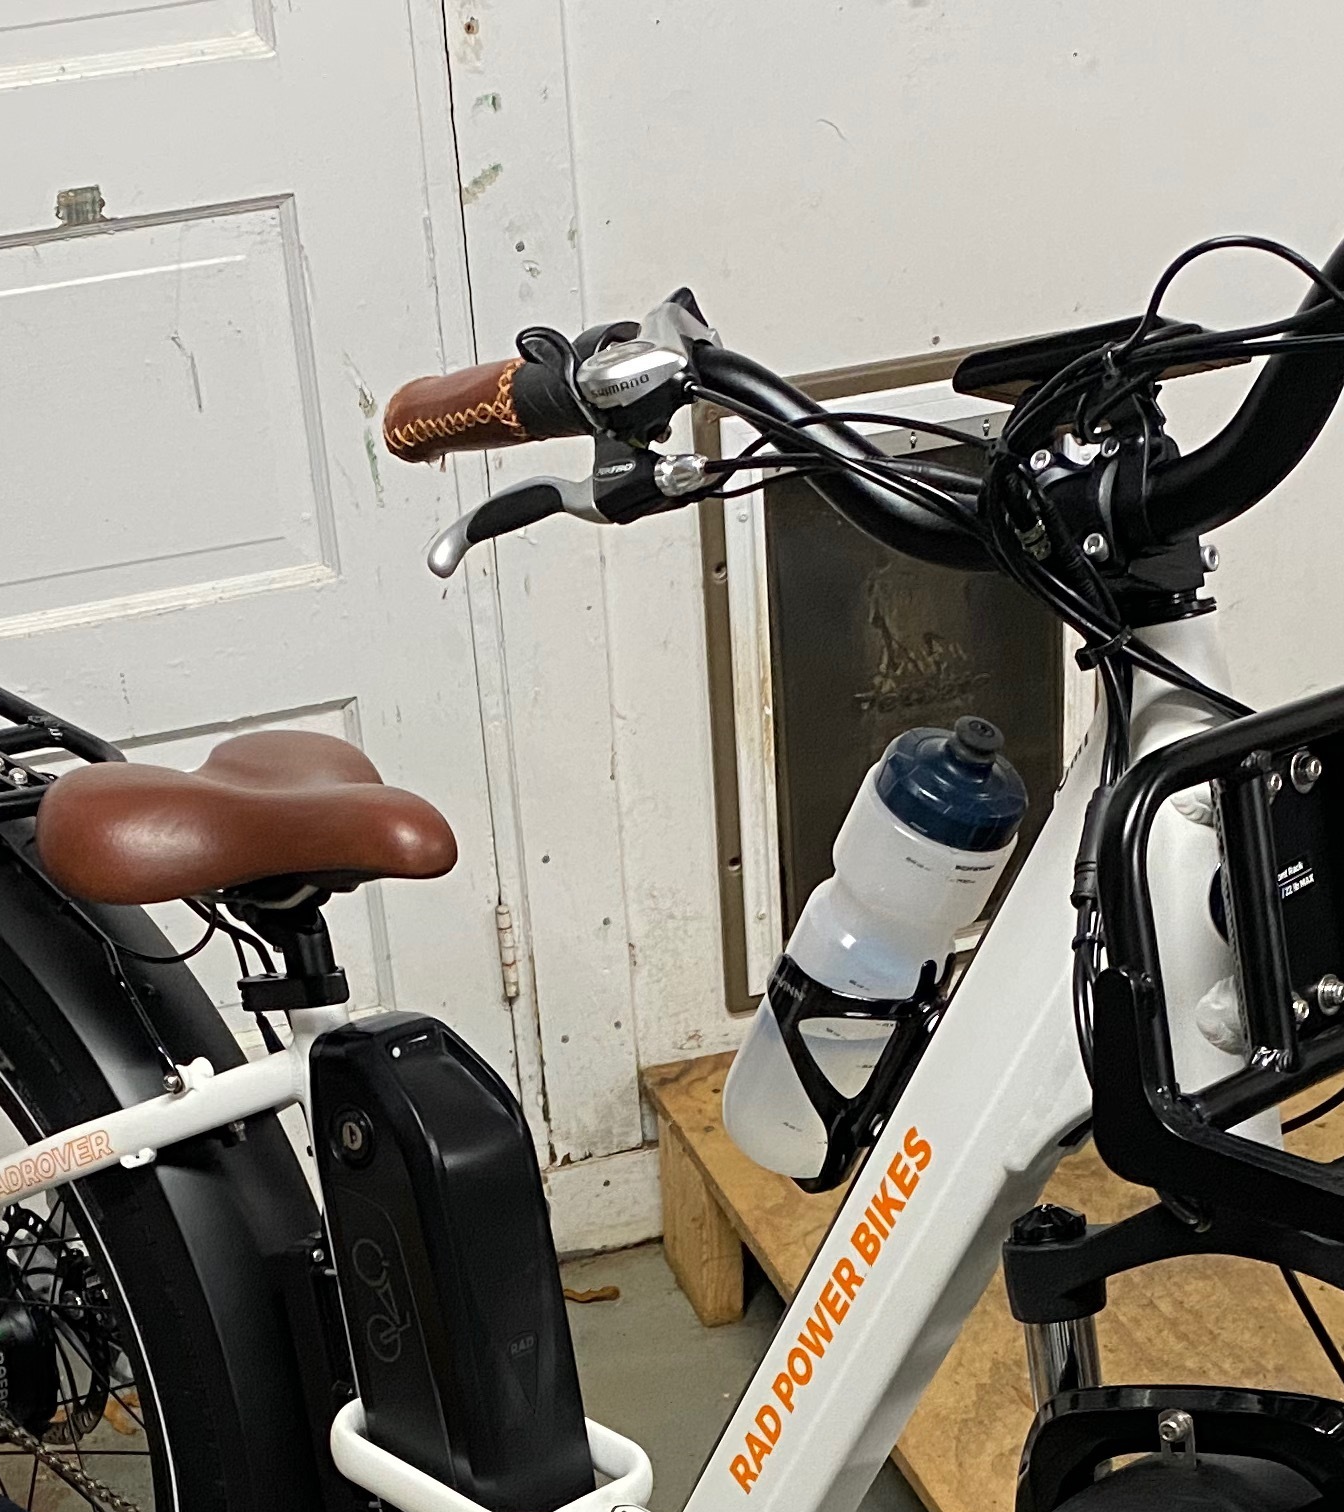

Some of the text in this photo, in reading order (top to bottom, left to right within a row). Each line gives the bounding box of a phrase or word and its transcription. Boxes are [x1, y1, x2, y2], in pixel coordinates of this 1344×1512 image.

[591, 373, 650, 399] SHIMANO
[1299, 873, 1315, 888] MAX
[729, 1126, 933, 1495] RAD POWER BIKES
[511, 1335, 534, 1355] RAD
